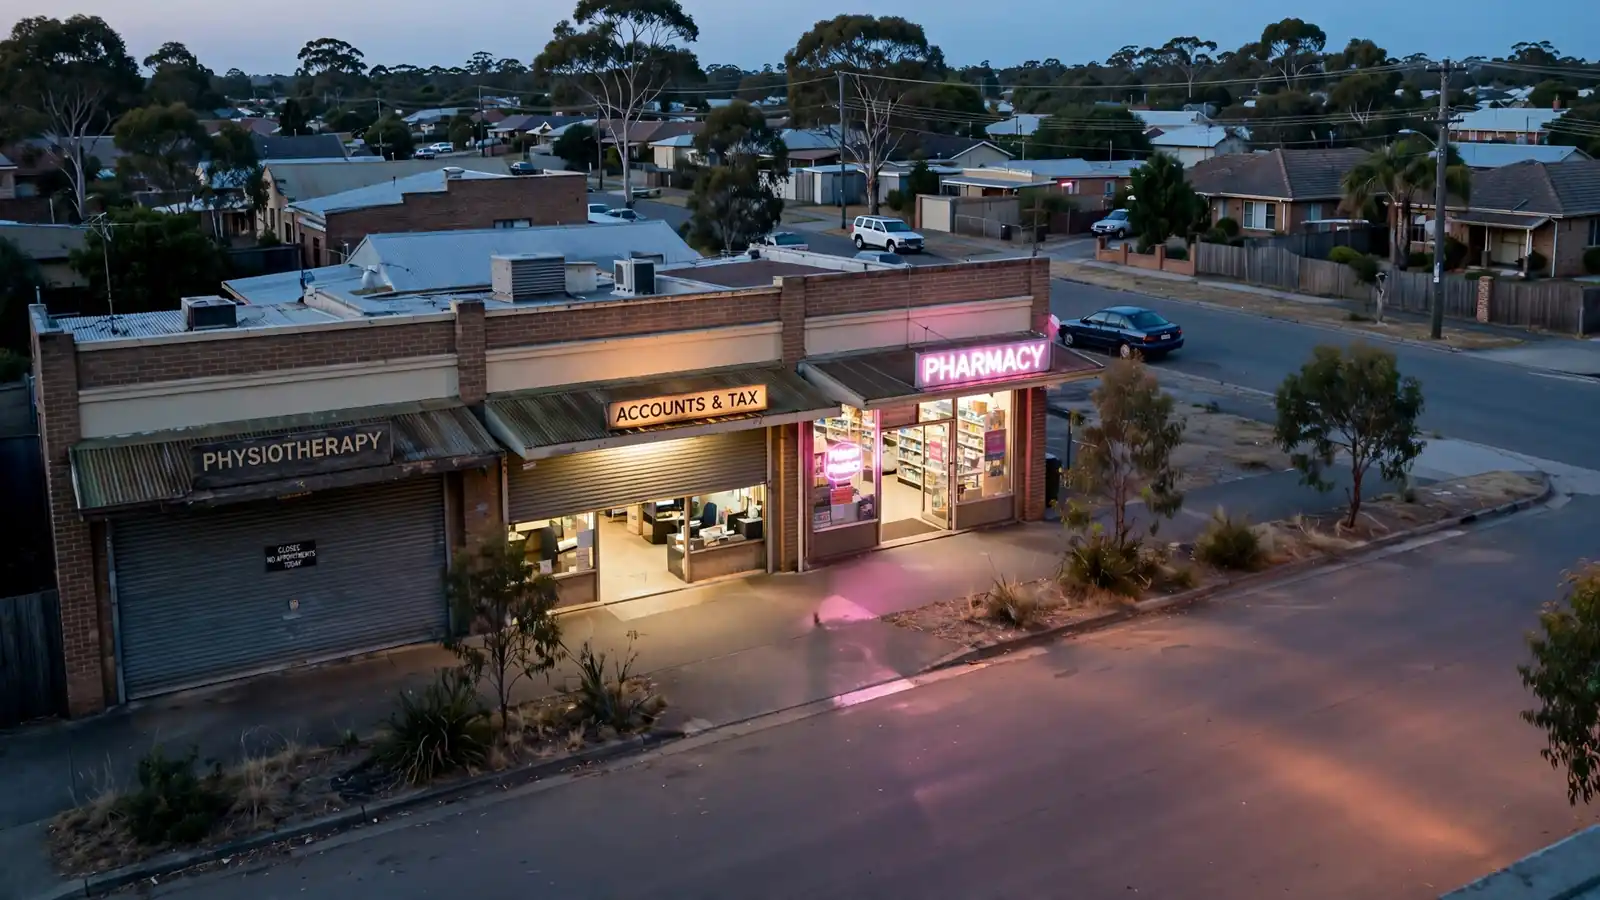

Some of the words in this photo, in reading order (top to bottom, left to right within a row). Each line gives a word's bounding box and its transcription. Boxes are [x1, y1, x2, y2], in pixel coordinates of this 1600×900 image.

[922, 344, 1045, 382] PHARMACY
[616, 397, 705, 422] ACCOUNTS
[712, 395, 722, 410] &
[728, 390, 758, 407] TAX
[203, 431, 382, 471] PHYSIOTHERAPY
[266, 556, 276, 564] NO
[284, 560, 302, 568] TODAY
